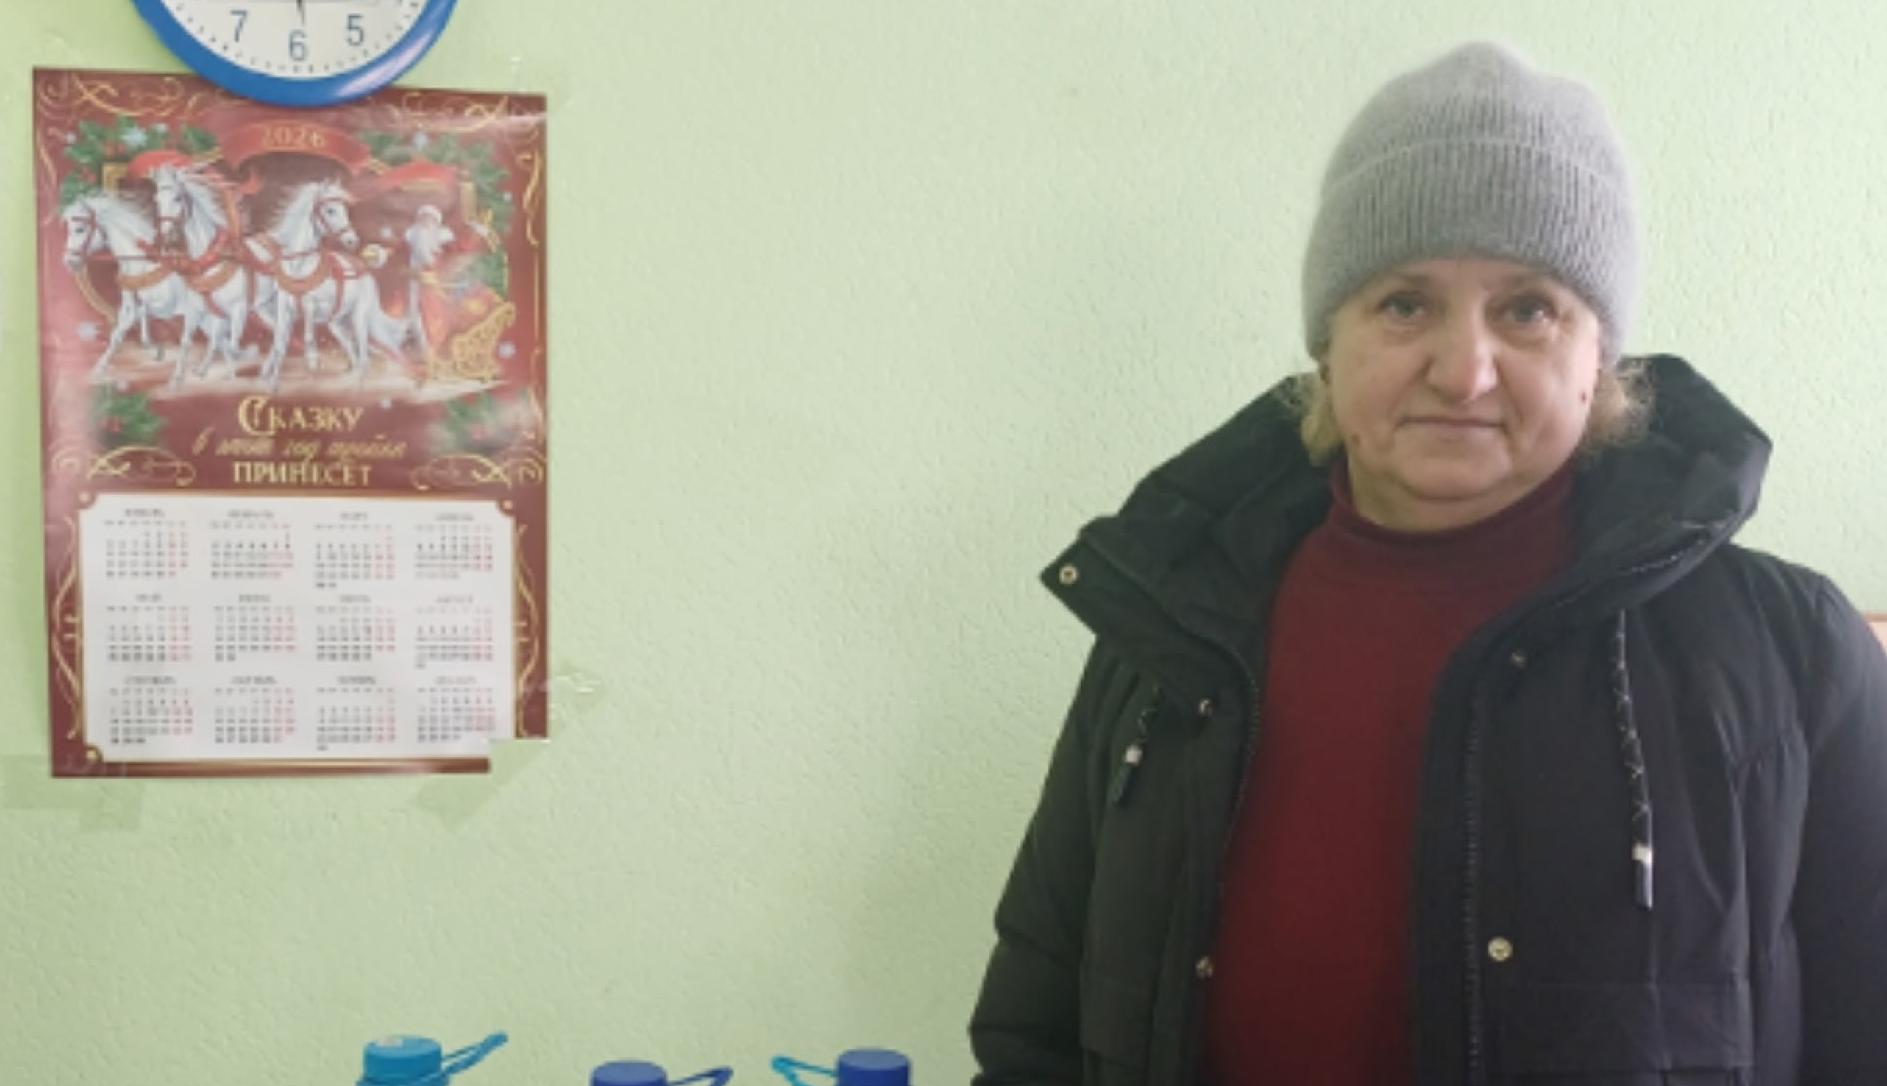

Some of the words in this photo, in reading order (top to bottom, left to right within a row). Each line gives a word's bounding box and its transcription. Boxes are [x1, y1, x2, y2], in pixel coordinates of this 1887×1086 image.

[230, 10, 248, 43] 7
[346, 14, 365, 47] 5
[289, 29, 307, 62] 6
[262, 125, 326, 149] 2026
